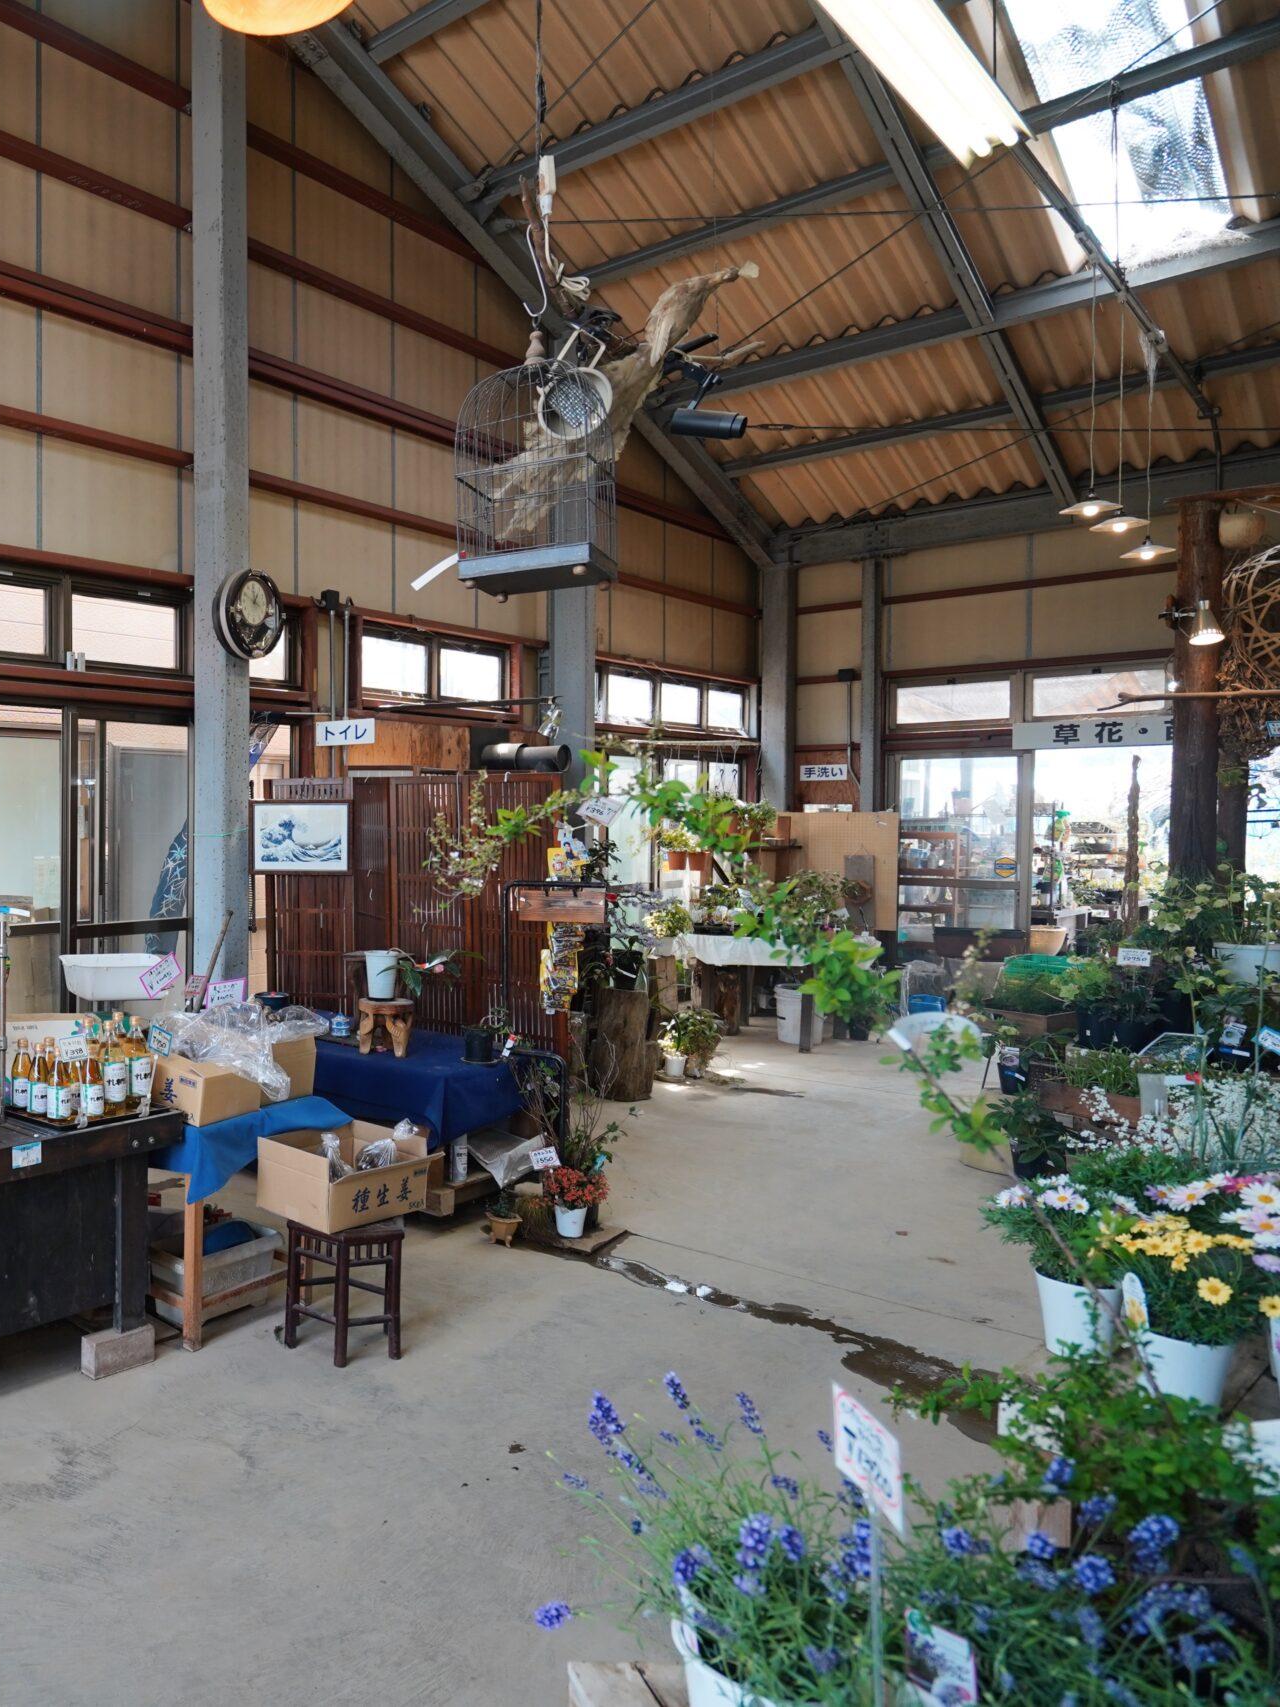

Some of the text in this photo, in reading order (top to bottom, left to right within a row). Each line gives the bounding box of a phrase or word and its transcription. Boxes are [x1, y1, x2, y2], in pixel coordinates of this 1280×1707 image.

[325, 724, 367, 741] トイレ
[804, 766, 843, 778] 手洗い
[352, 1177, 412, 1214] 種生姜
